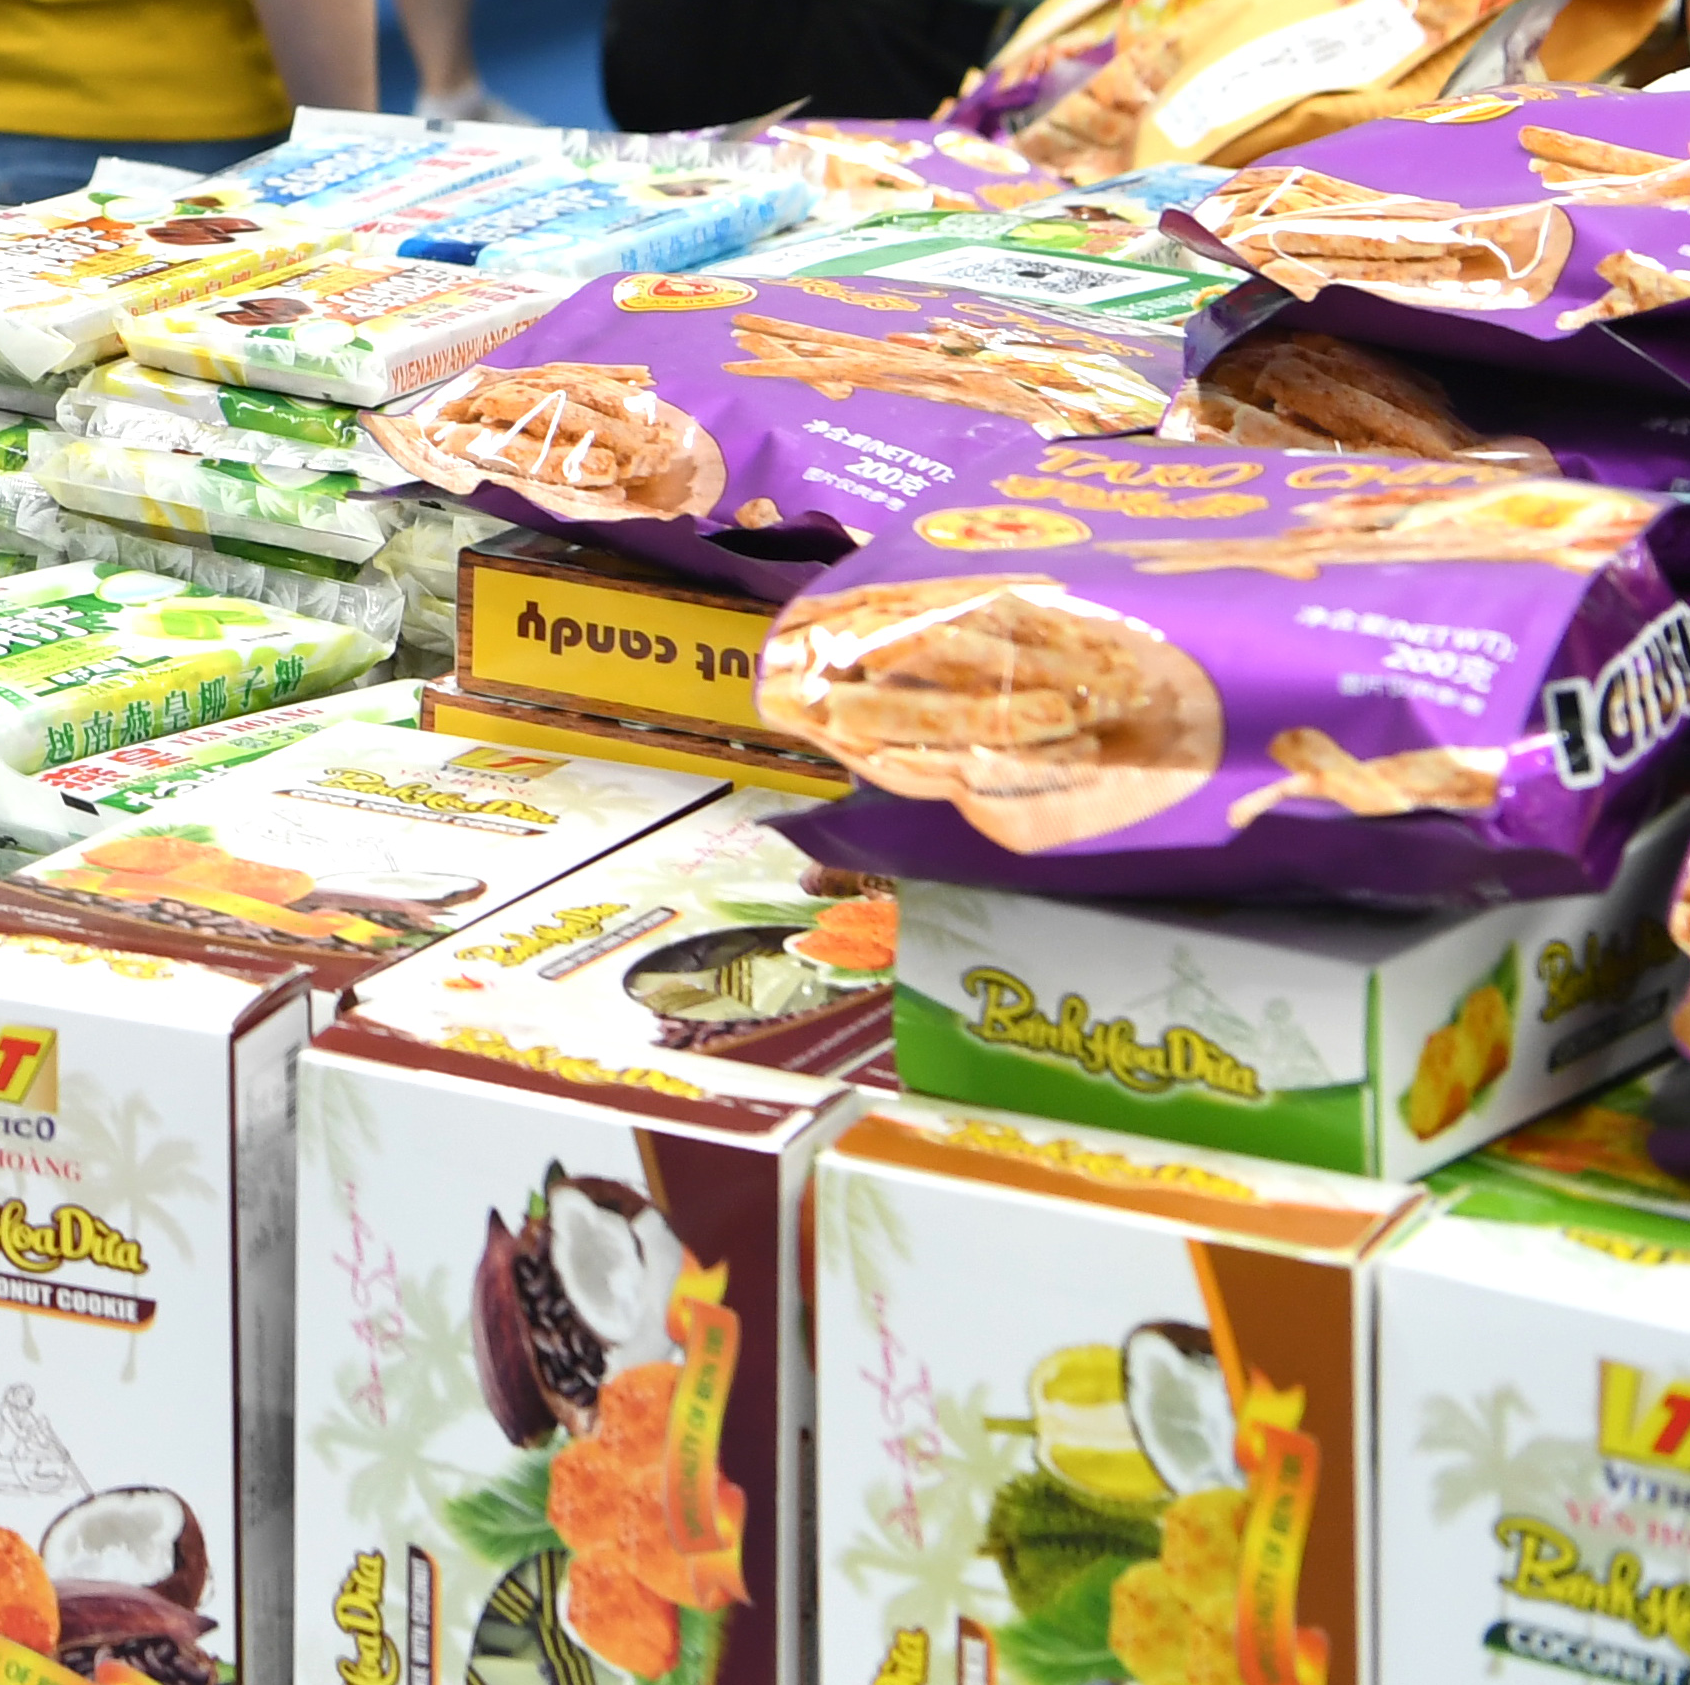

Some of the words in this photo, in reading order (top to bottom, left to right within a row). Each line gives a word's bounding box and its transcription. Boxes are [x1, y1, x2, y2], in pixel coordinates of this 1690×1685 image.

[844, 454, 934, 498] 200克
[1036, 445, 1265, 491] TARO
[516, 599, 677, 666] candy
[1383, 640, 1500, 693] 200克
[44, 653, 307, 766] 越南燕皇椰子糖
[55, 1286, 141, 1324] COOKIE
